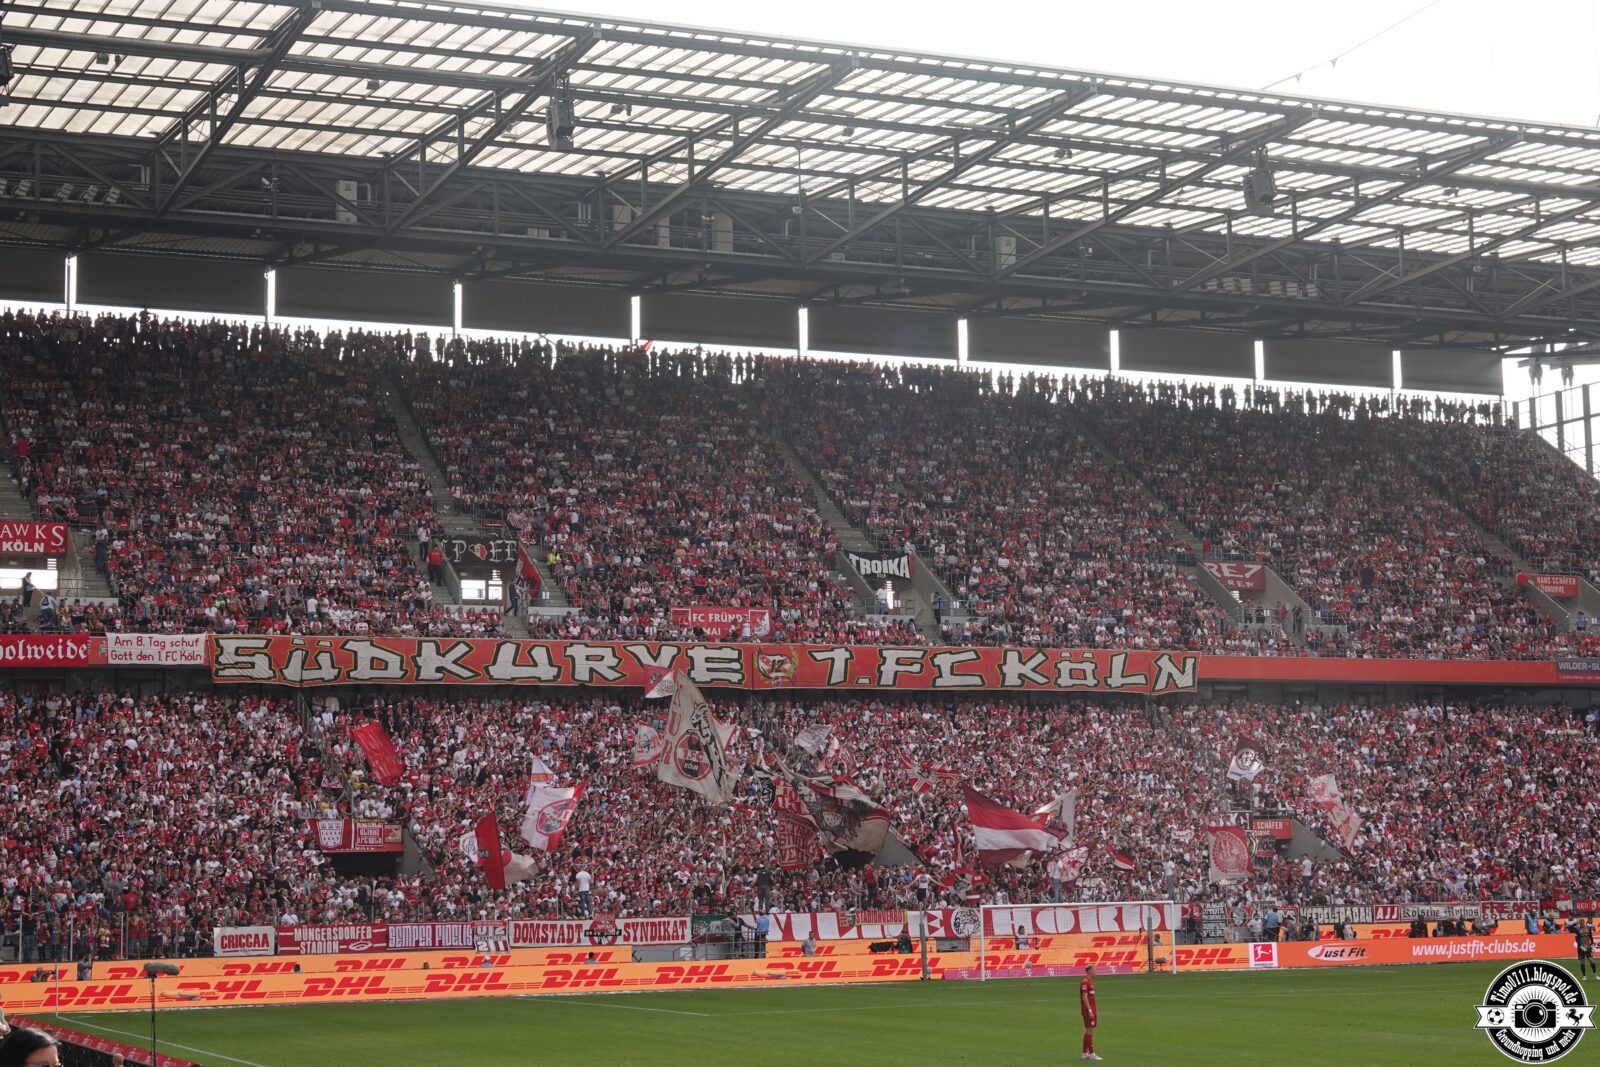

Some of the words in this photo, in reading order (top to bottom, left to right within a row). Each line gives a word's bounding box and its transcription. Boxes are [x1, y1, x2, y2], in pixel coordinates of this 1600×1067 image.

[2, 538, 45, 553] KÖLN
[848, 552, 911, 579] TROIKA
[692, 613, 705, 623] FC
[114, 635, 133, 647] Am
[148, 636, 166, 650] Tag
[169, 637, 200, 648] schuf
[110, 649, 133, 661] Gott
[136, 650, 154, 661] den
[180, 650, 202, 661] Köln
[213, 637, 745, 684] SÜDKURVE
[1000, 649, 1197, 692] KÖLN
[513, 922, 584, 944] DOMSTADT
[623, 919, 687, 942] SYNDIKAT
[300, 940, 339, 954] STADION
[1169, 947, 1237, 966] DHL
[1315, 946, 1346, 958] Just
[1348, 946, 1367, 957] Fit
[1411, 938, 1536, 958] www.justfit-clubs.de
[423, 972, 510, 993] DHL
[541, 968, 624, 989] DHL
[654, 964, 734, 985] DHL
[42, 984, 139, 1007] DHL
[301, 976, 389, 998] DHL
